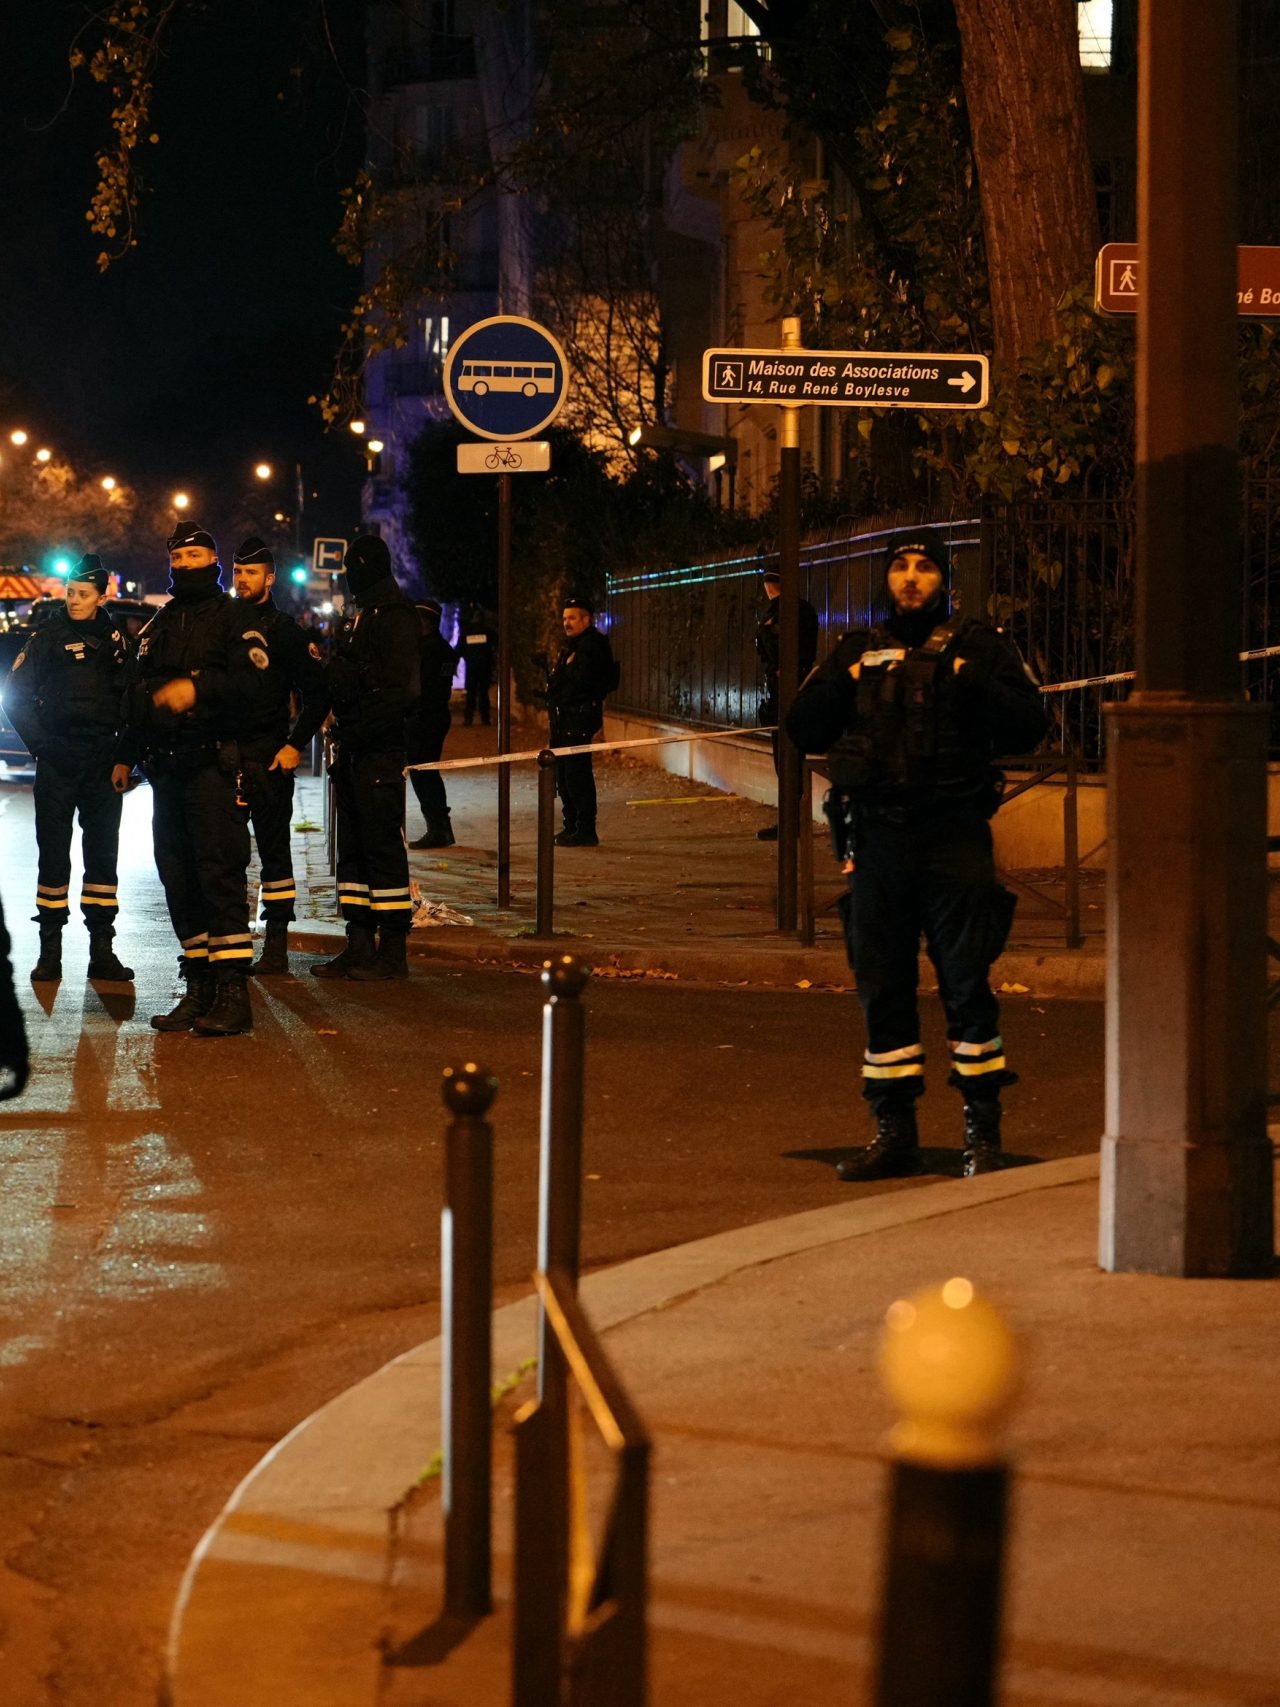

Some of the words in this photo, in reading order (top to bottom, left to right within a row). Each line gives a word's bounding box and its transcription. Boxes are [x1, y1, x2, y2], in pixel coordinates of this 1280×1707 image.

[1236, 288, 1253, 304] né
[748, 360, 804, 376] Maison
[809, 362, 836, 377] des
[841, 362, 939, 380] Associations
[747, 380, 764, 395] 14,
[769, 381, 796, 394] Rue
[802, 382, 838, 395] René
[844, 382, 910, 398] Boylesve
